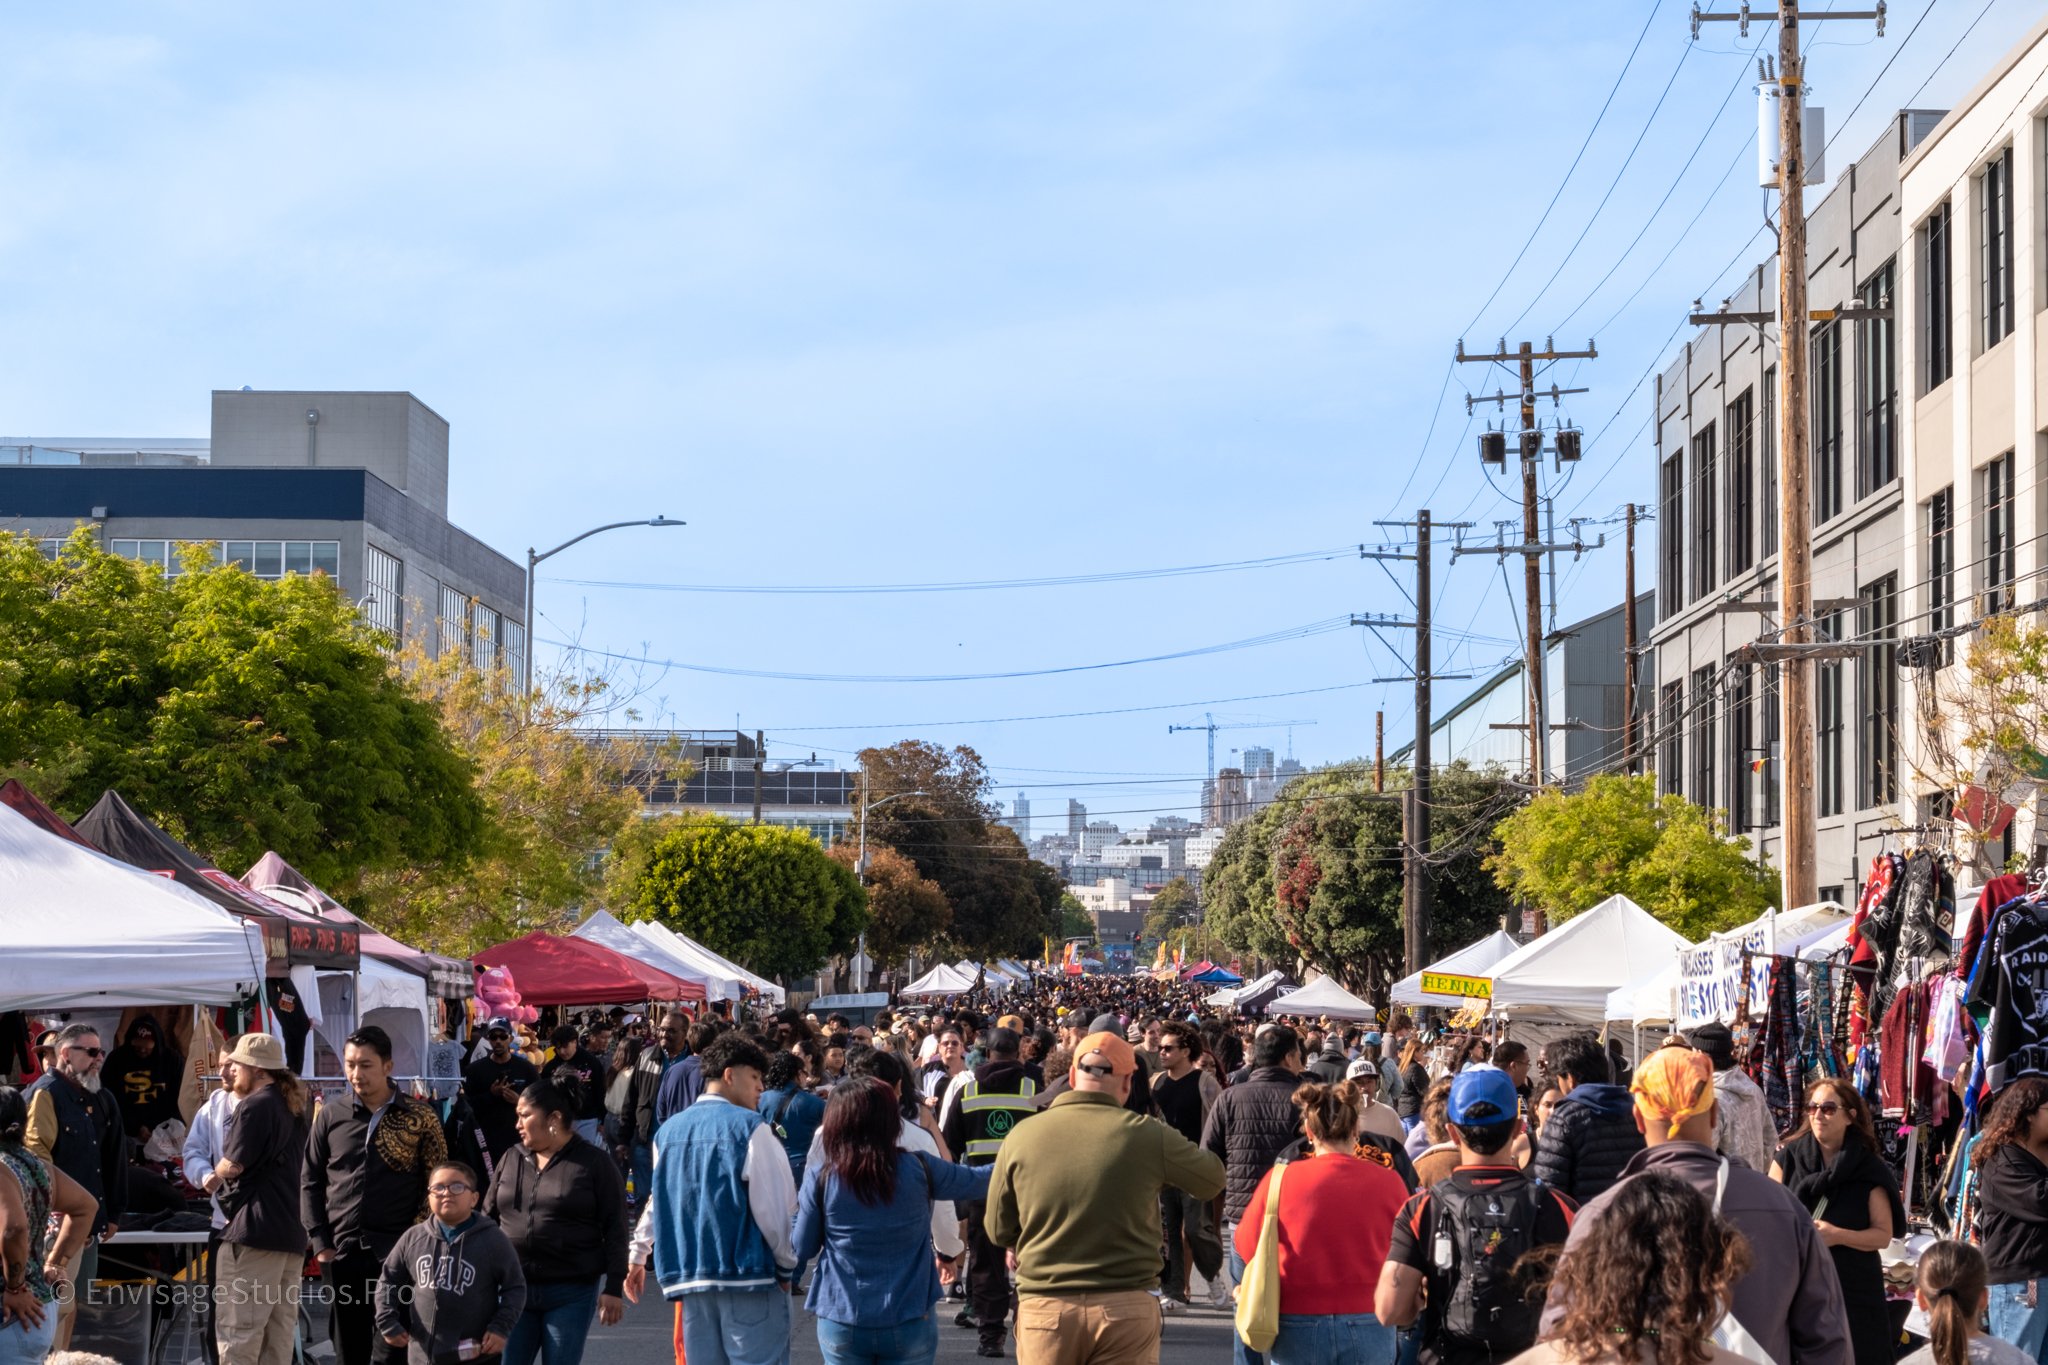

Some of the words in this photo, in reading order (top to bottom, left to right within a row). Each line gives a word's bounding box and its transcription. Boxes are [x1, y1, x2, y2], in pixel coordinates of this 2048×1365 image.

[1424, 976, 1488, 995] HENNA
[1354, 1063, 1373, 1075] BULLS
[416, 1254, 476, 1296] GAP
